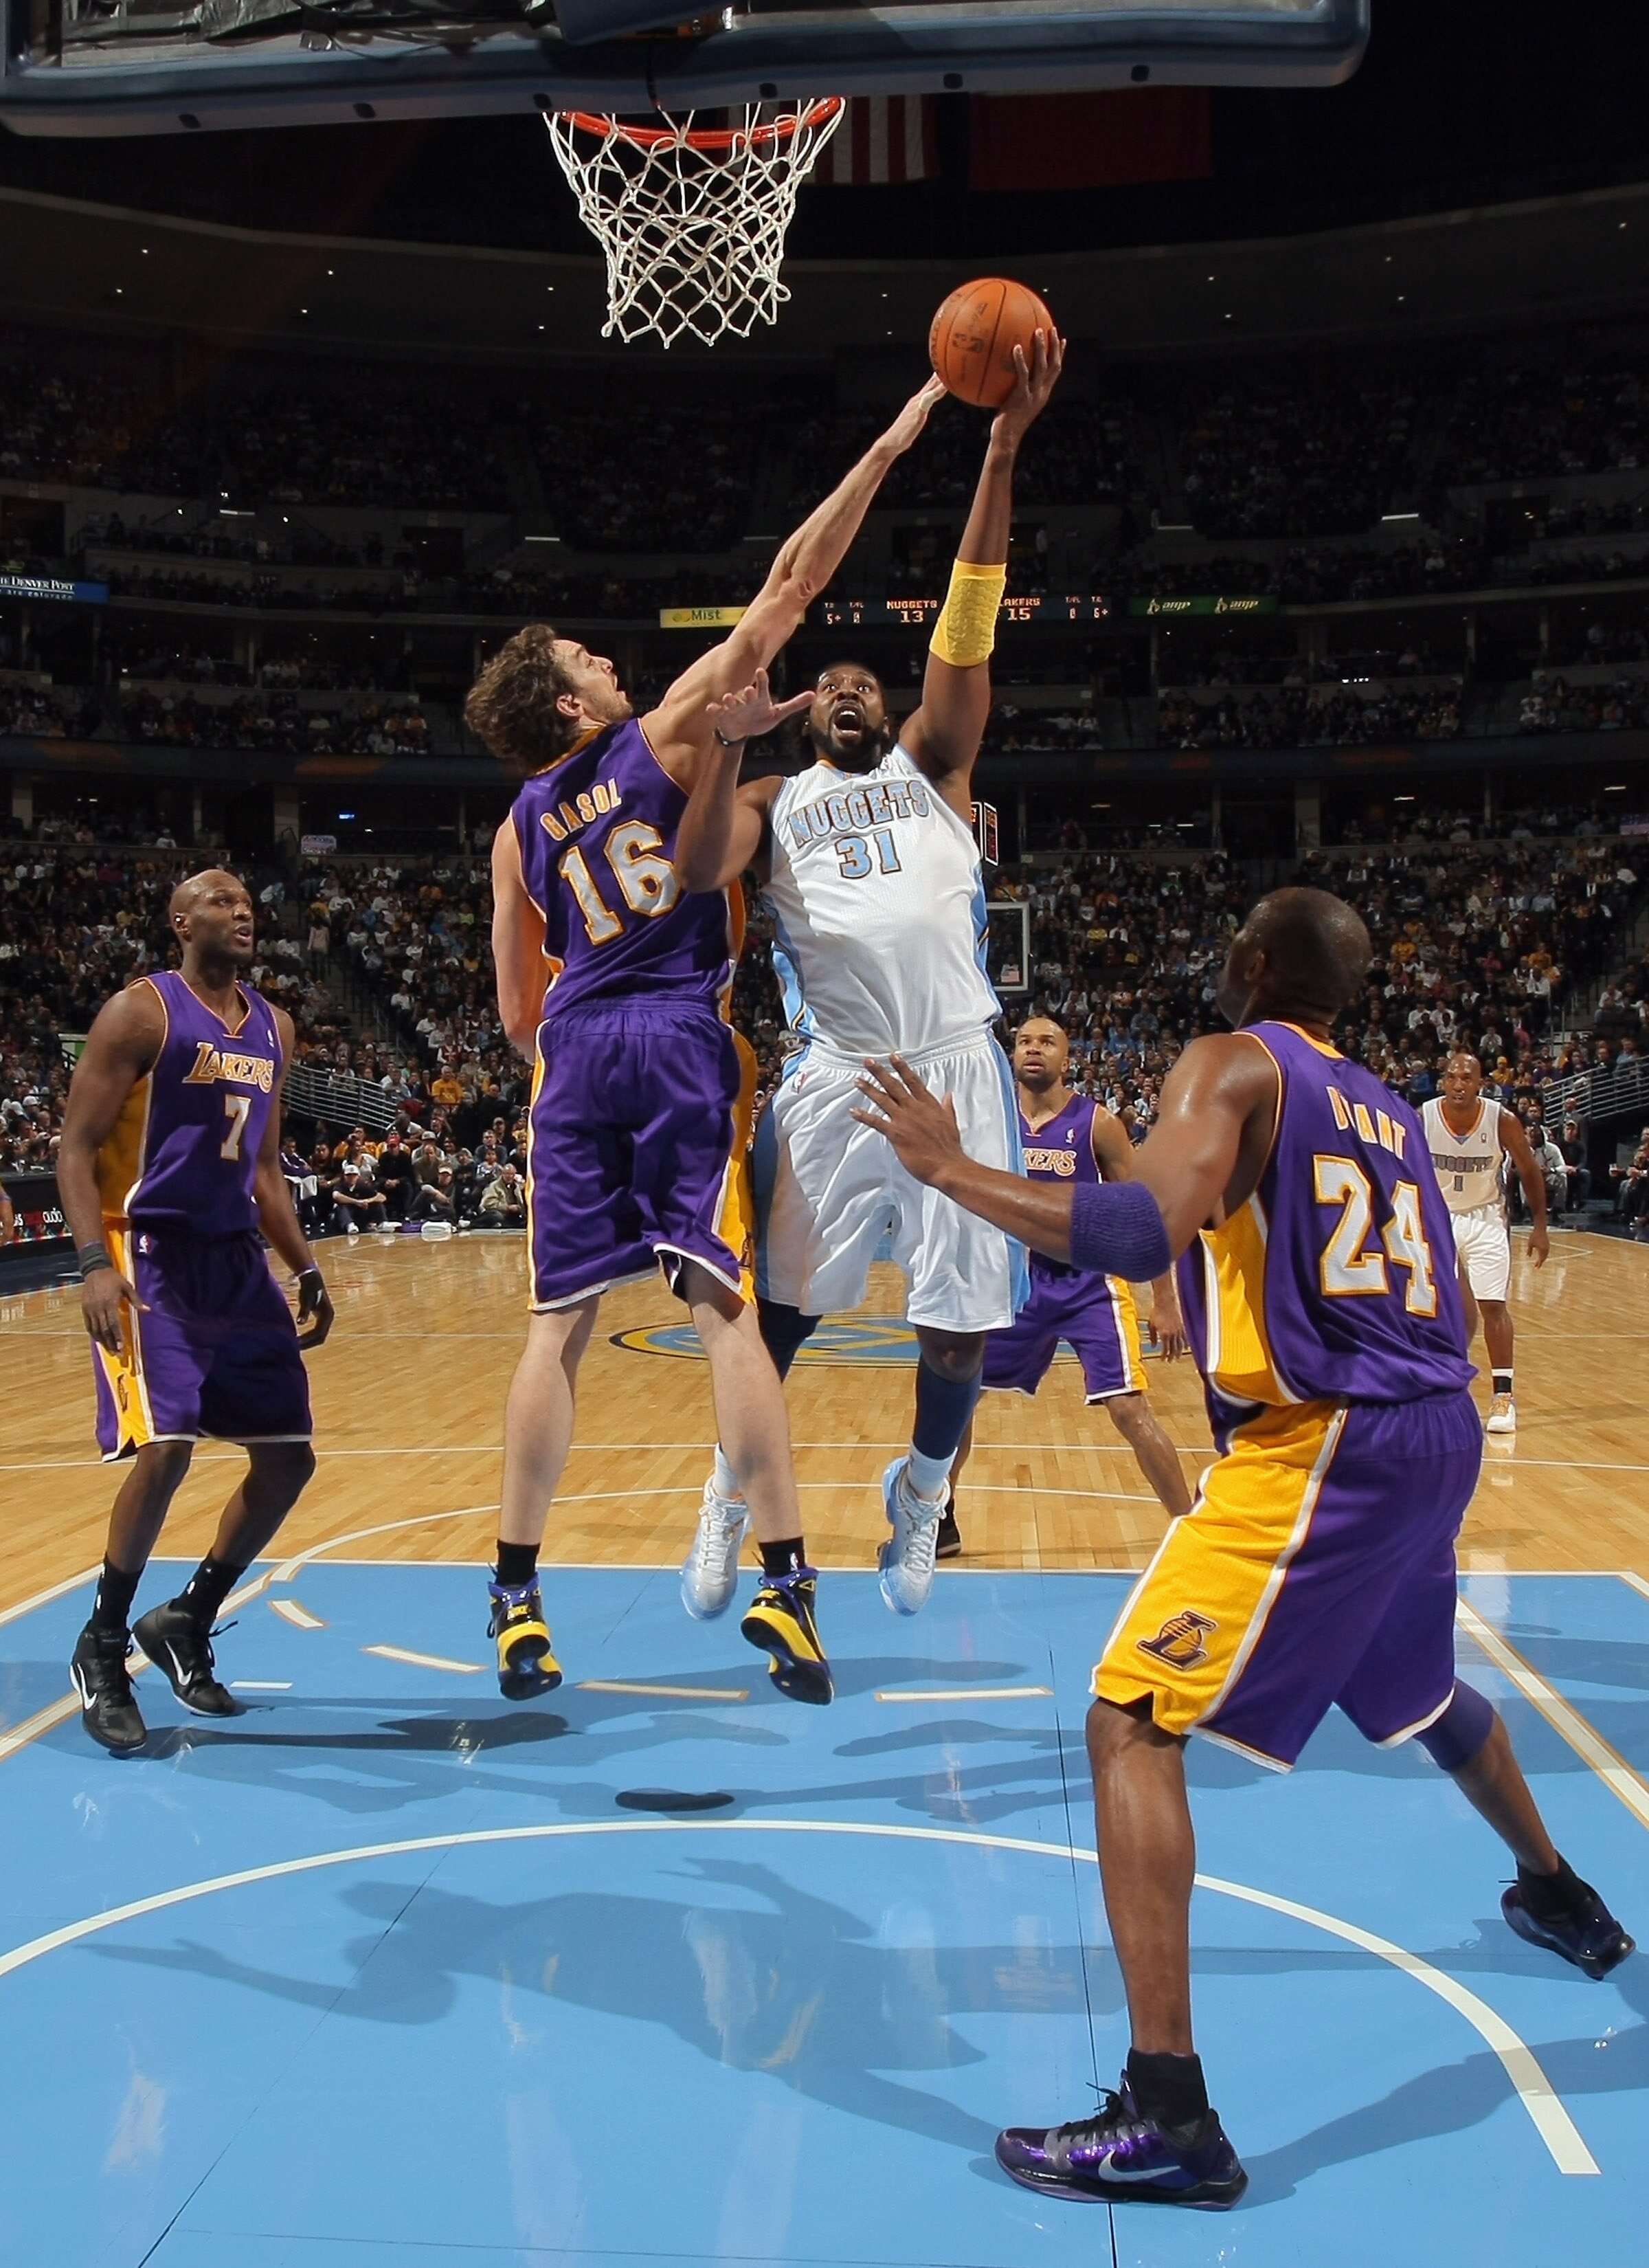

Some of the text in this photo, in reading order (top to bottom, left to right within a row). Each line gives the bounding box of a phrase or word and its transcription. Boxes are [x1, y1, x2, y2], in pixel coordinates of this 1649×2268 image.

[691, 609, 721, 621] Mist
[886, 600, 937, 610] NUGGETS
[1000, 597, 1041, 606] AKERS
[1007, 608, 1031, 621] 15
[900, 610, 924, 623] 13
[788, 779, 930, 849] NUGGETS
[834, 828, 902, 879] 31
[557, 819, 682, 946] 16
[181, 1041, 274, 1094] LAKERS
[221, 1093, 252, 1161] 7
[1022, 1148, 1077, 1177] KERS
[1453, 1175, 1463, 1192] 1
[1312, 1153, 1438, 1319] 24
